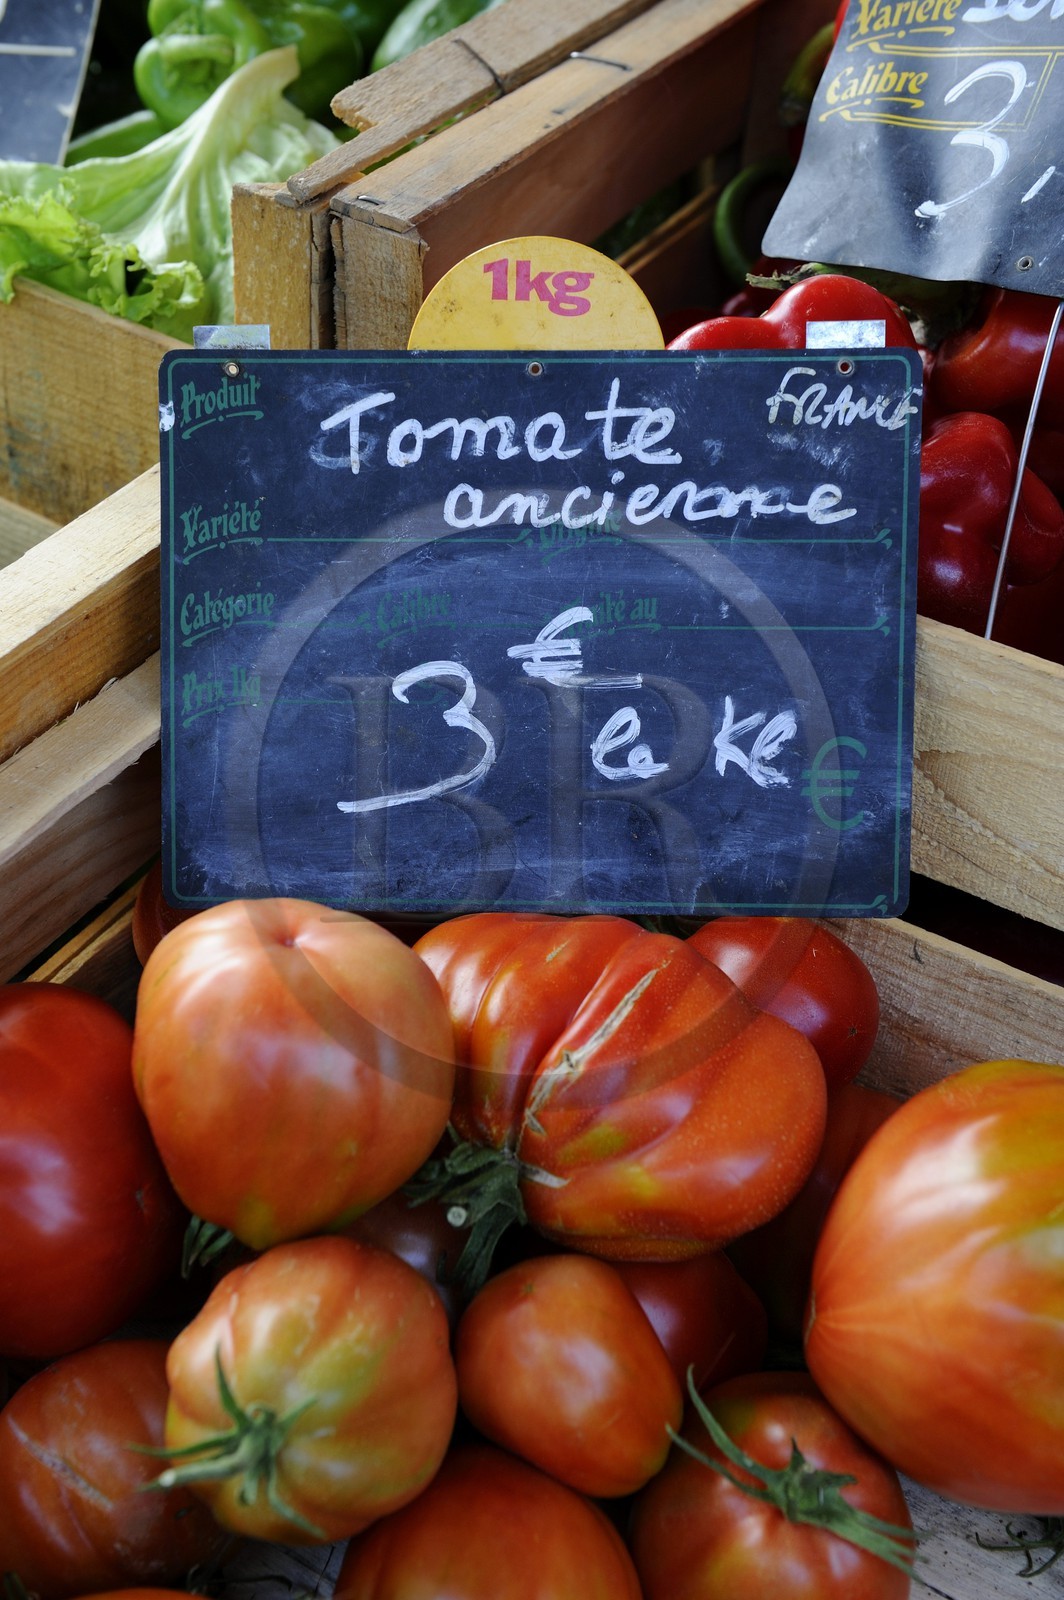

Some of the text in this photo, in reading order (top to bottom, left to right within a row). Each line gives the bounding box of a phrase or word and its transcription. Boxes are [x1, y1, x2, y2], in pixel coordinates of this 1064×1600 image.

[825, 61, 929, 105] Calibre
[483, 258, 595, 317] 1kg
[180, 371, 262, 428] Produit
[319, 377, 683, 475] Tomate
[180, 499, 262, 554] Variété
[443, 470, 858, 529] ancienne
[180, 581, 276, 636] Catégorie
[629, 597, 658, 621] au
[336, 660, 497, 814] 3
